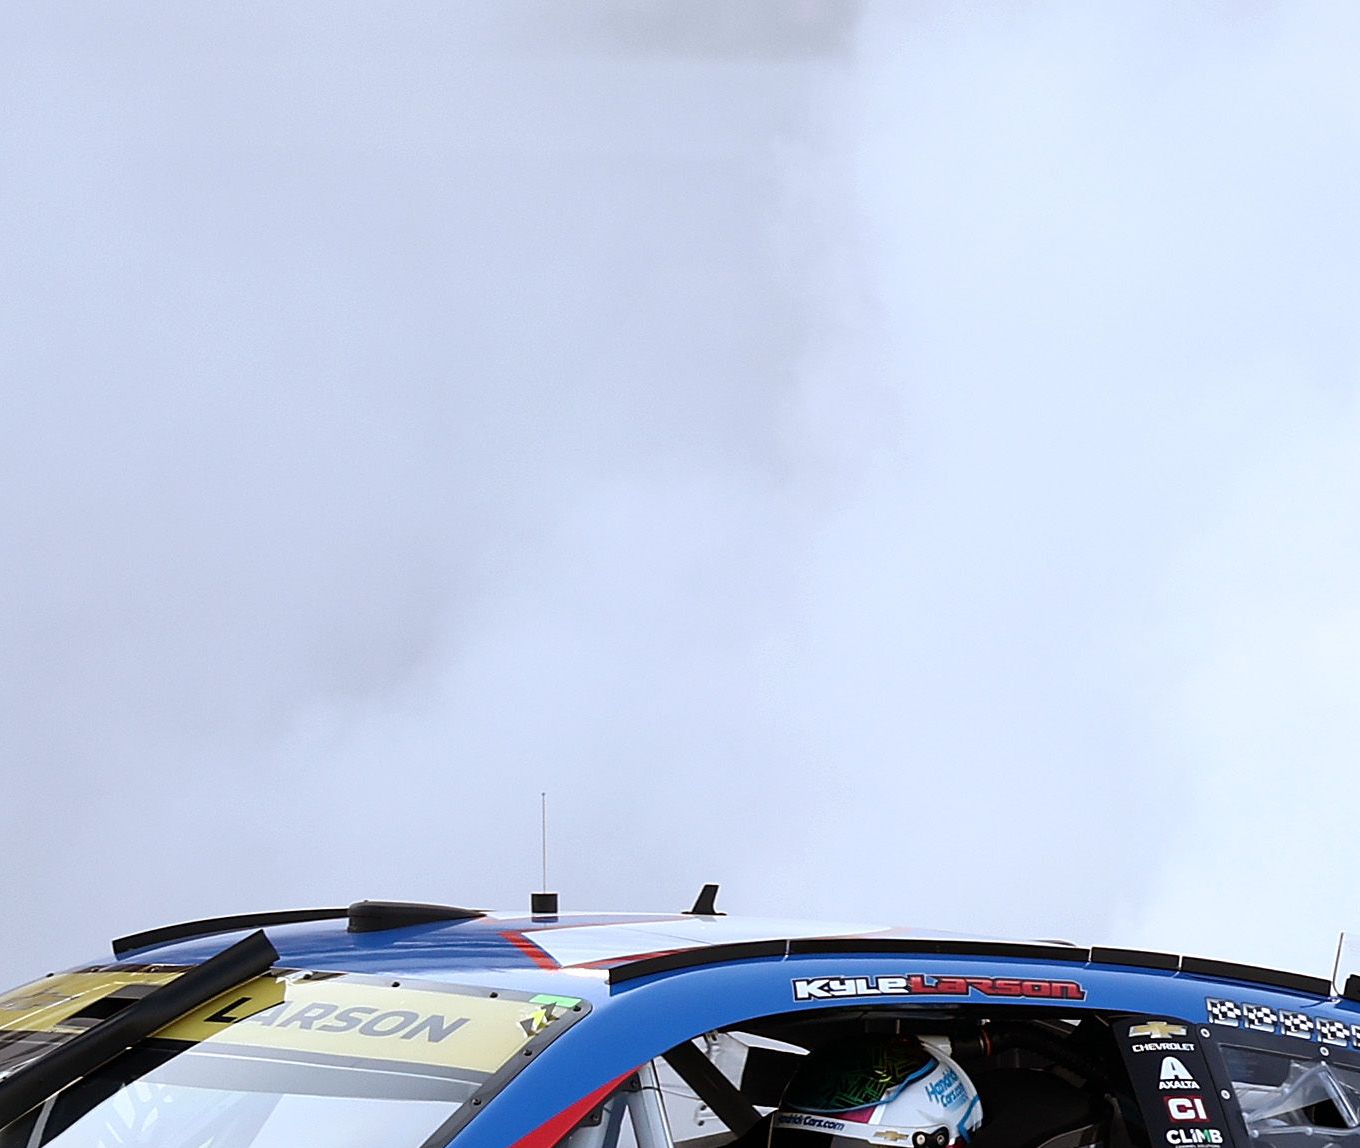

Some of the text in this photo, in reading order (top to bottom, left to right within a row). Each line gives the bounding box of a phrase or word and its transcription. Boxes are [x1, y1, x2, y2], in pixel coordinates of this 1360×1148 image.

[203, 997, 470, 1044] LARSON
[1132, 1043, 1195, 1052] CHEVROLET
[1159, 1081, 1200, 1090] AXALTA
